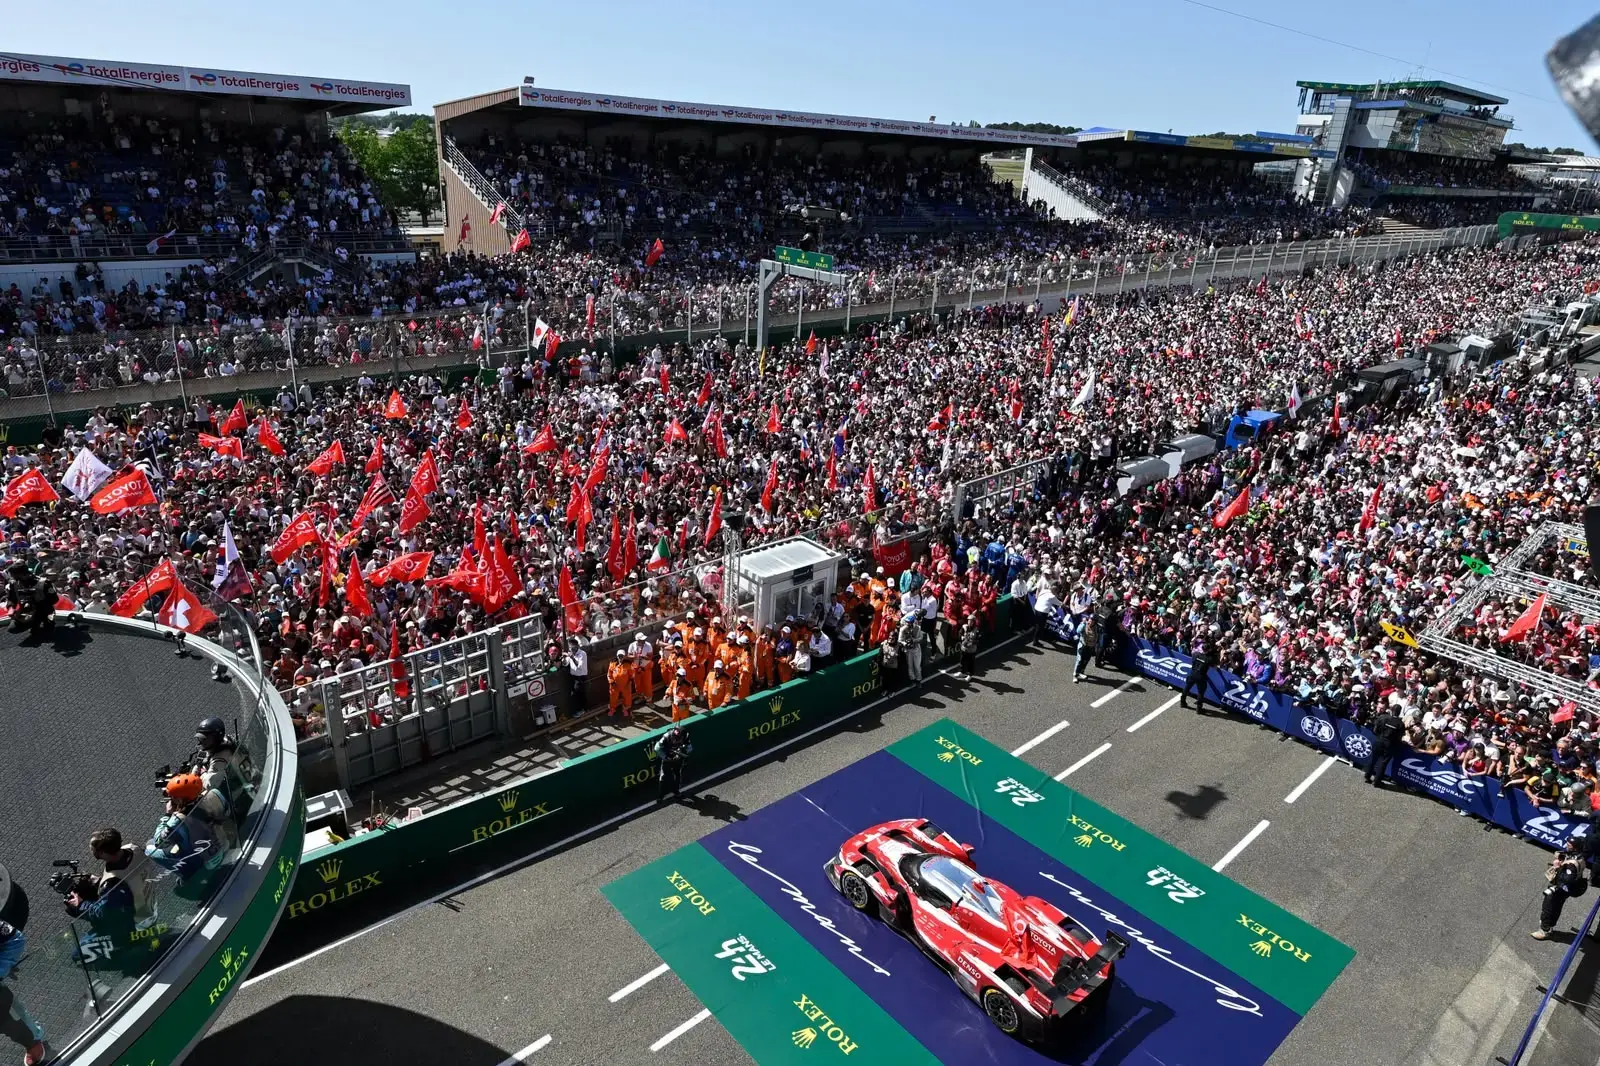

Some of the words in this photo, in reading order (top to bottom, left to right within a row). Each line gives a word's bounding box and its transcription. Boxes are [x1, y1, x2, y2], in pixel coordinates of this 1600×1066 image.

[86, 65, 180, 83] TotalEnergies
[218, 75, 300, 92] TotalEnergies
[335, 84, 405, 99] TotalEnergies
[540, 93, 591, 107] TotalEnergies
[612, 100, 658, 113] TotalEnergies
[676, 105, 718, 118] TotalEnergies
[734, 110, 772, 121] TotalEnergies
[787, 114, 822, 125] TotalEnergies
[1470, 561, 1484, 571] 87
[1391, 628, 1406, 640] 78
[852, 672, 883, 699] ROL
[1221, 697, 1233, 706] LE
[748, 710, 801, 740] ROLEX
[934, 735, 984, 767] ROLEX
[1397, 771, 1445, 794] CHAMPIONSHIP
[1410, 772, 1433, 786] WORLD
[1433, 782, 1473, 803] ENDURANCE
[472, 801, 550, 842] ROLEX
[1066, 813, 1127, 853] ROLEX
[1521, 824, 1540, 837] LE
[273, 859, 294, 905] ROLEX
[665, 870, 716, 916] ROLEX
[1189, 885, 1206, 896] LE
[287, 871, 384, 920] ROLEX
[1029, 931, 1057, 955] TOYOTA
[1235, 913, 1313, 964] ROLEX
[207, 945, 250, 1006] ROLEX
[760, 958, 777, 971] LE
[957, 956, 982, 980] DENSO
[793, 993, 859, 1056] ROLEX
